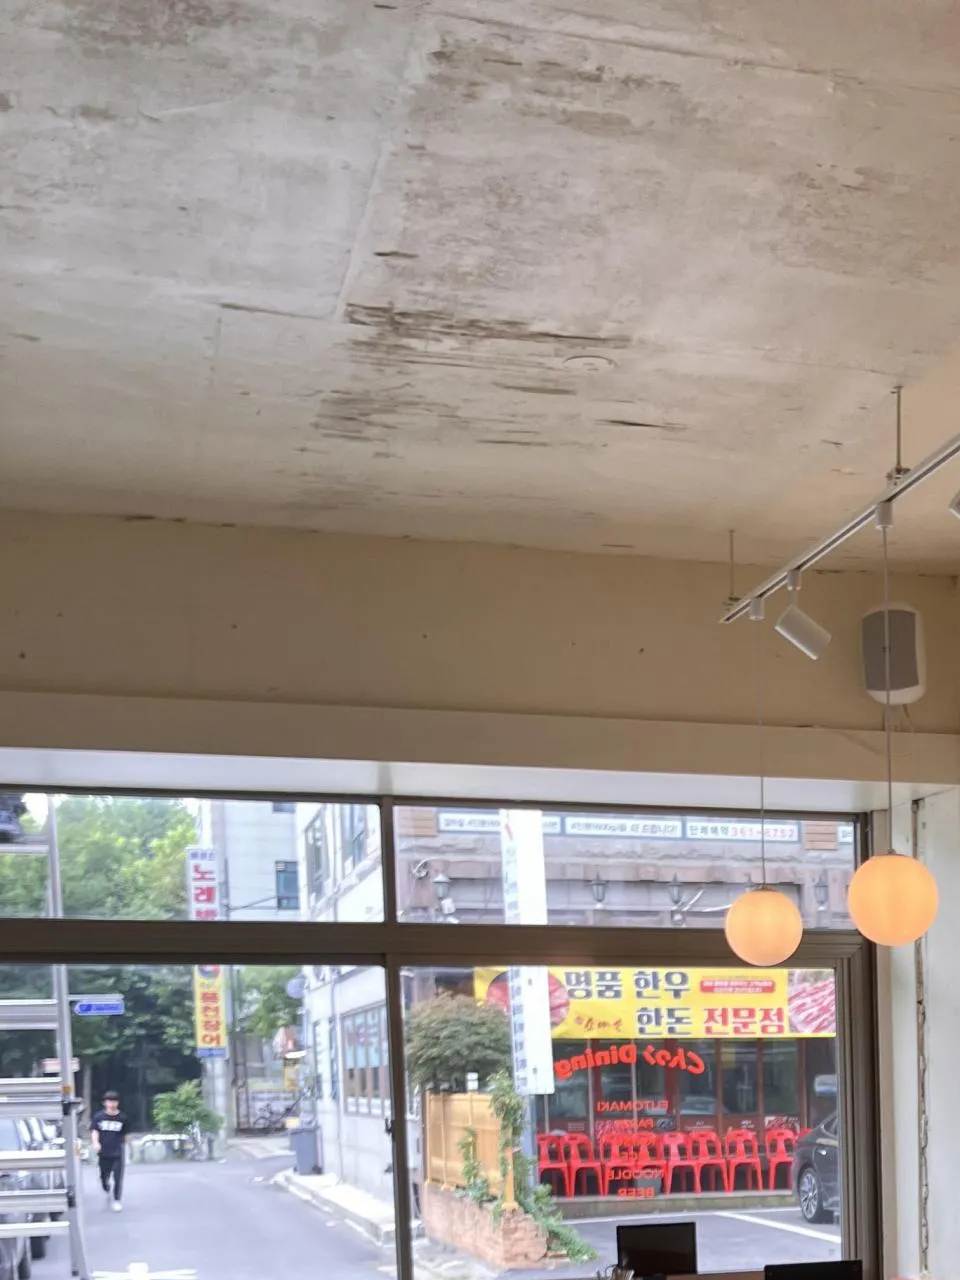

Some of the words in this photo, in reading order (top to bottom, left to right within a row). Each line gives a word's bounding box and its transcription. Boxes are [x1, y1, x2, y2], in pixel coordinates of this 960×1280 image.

[564, 970, 622, 1000] 명품
[634, 970, 690, 999] 한우
[637, 1007, 692, 1035] 한돈
[703, 1007, 785, 1035] 전문점
